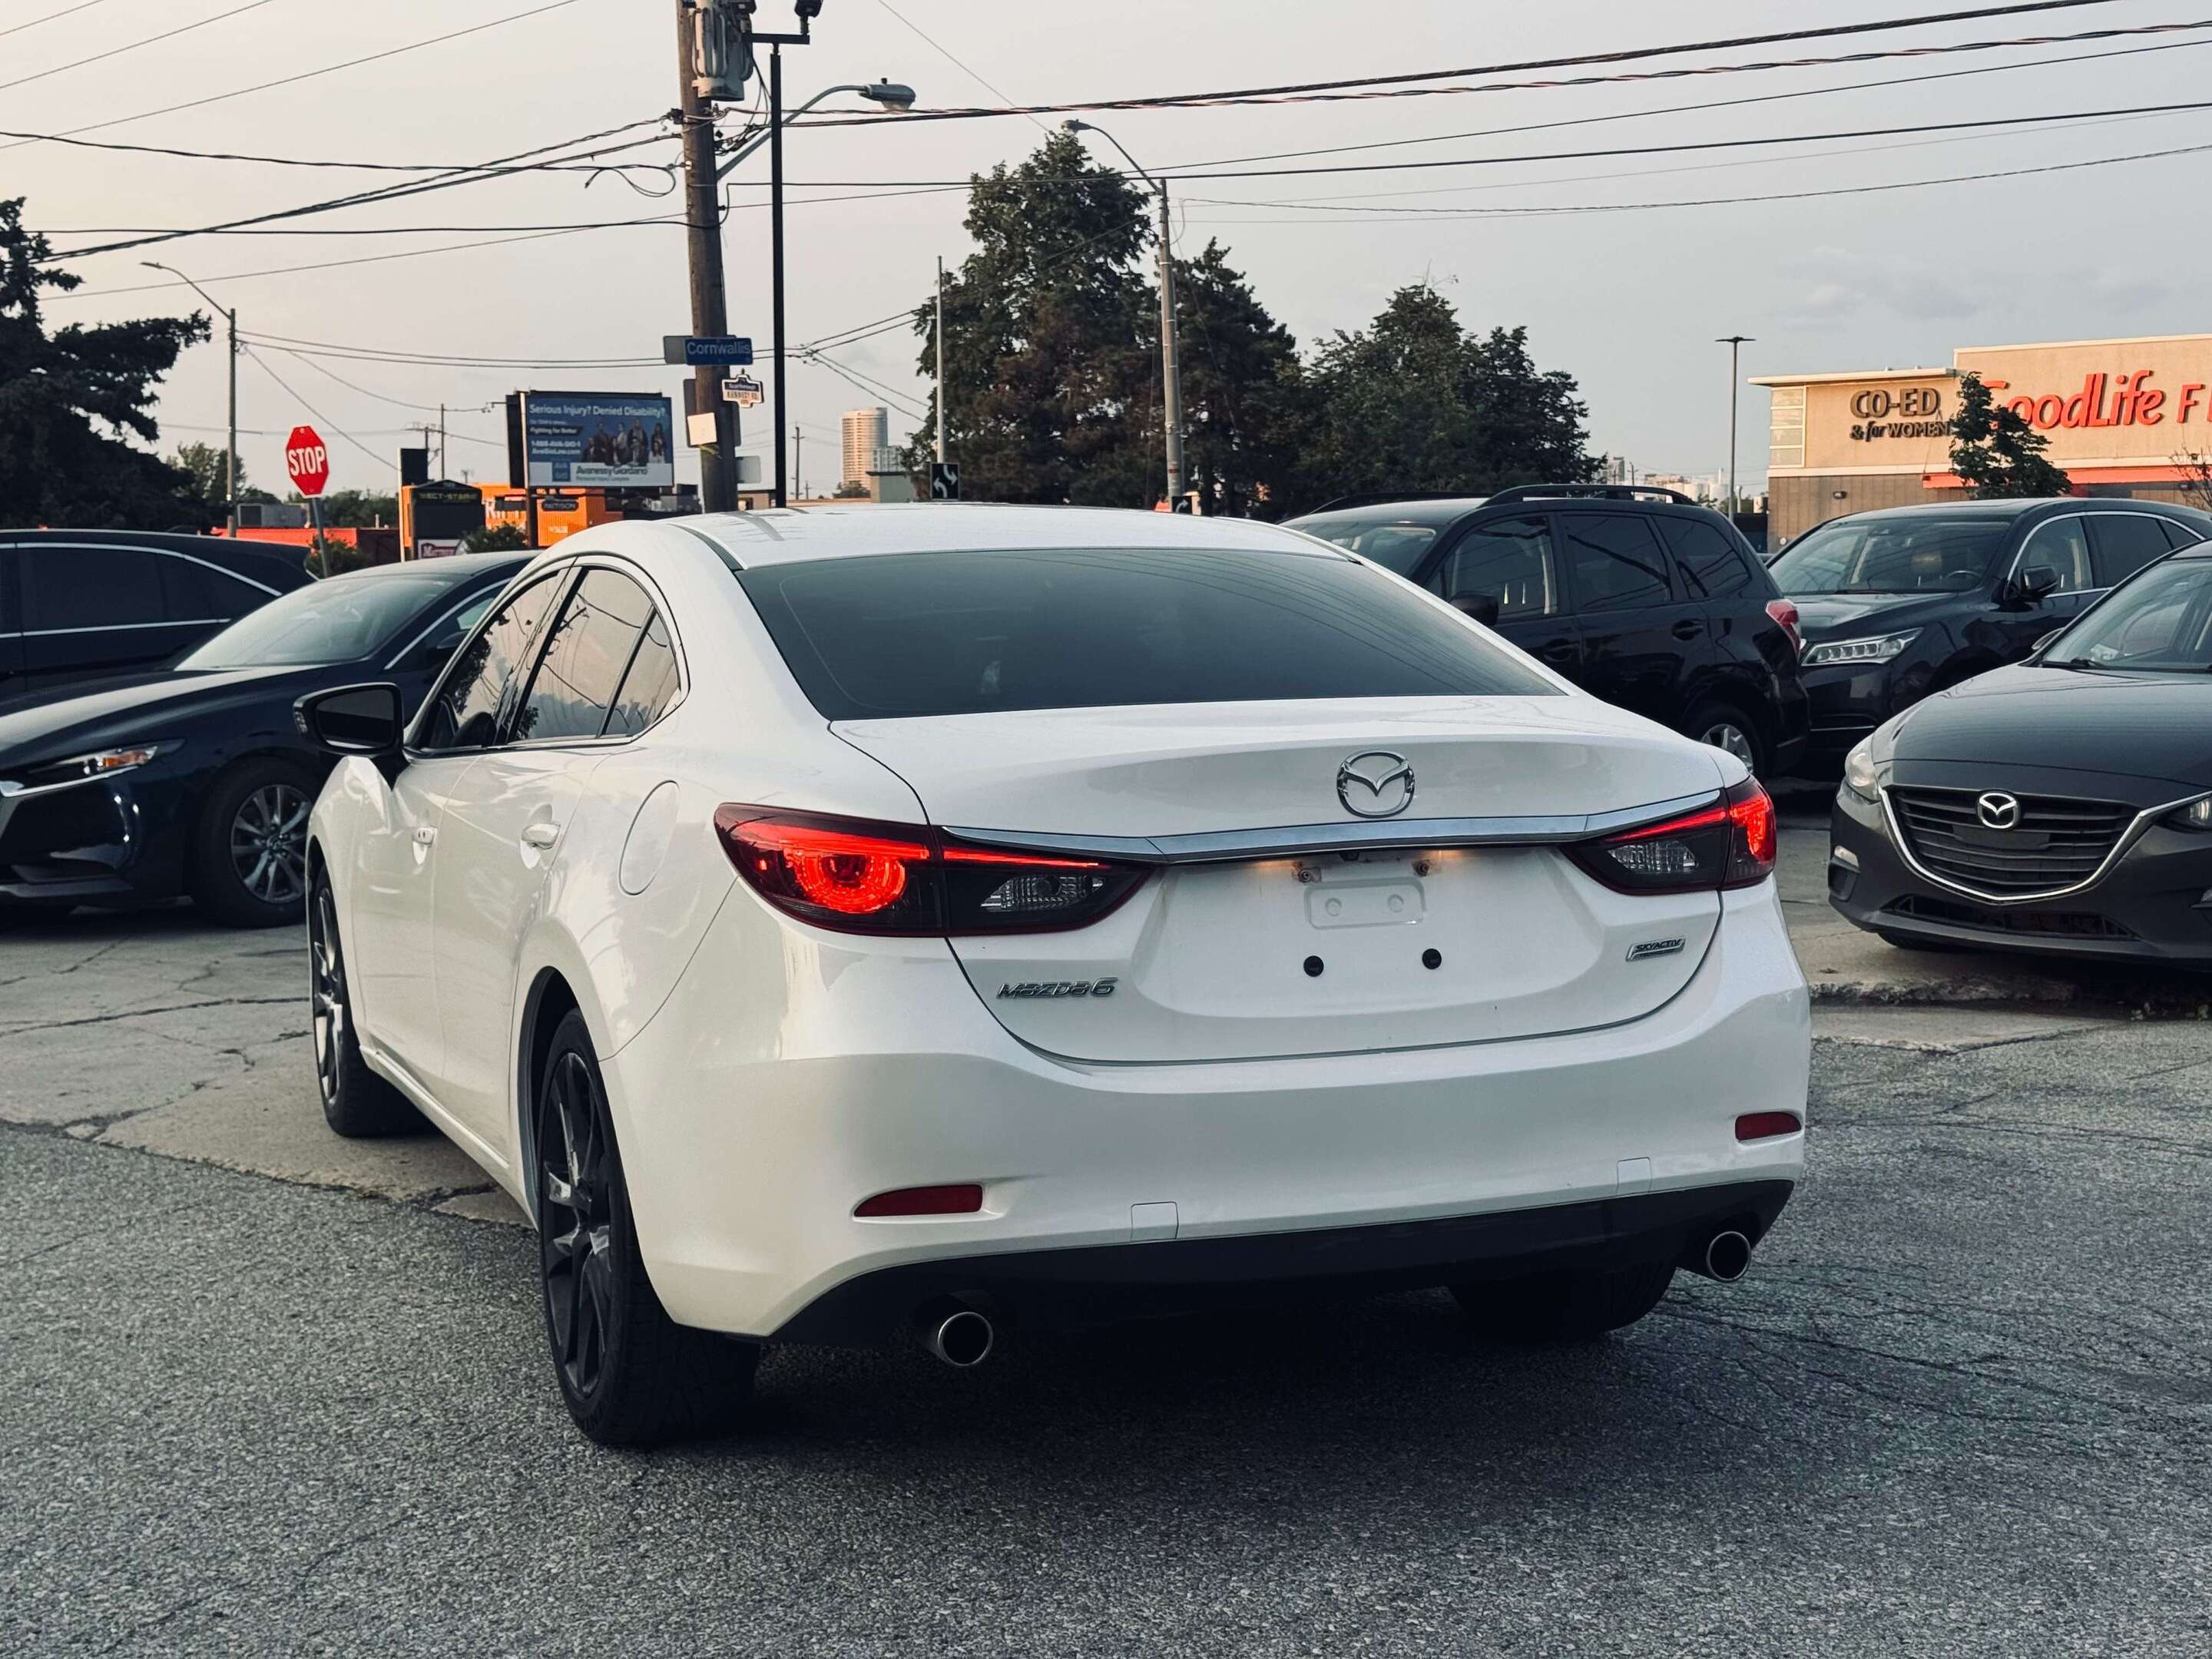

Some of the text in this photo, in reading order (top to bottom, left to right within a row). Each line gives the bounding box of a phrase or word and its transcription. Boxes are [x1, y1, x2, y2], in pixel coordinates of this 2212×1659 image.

[687, 341, 750, 355] Cornwallis
[529, 404, 666, 418] Serious Injury? Denied Disability?
[1849, 388, 1941, 419] CO-ED
[1849, 421, 1951, 442] & for WOMEN
[288, 446, 325, 476] STOP
[1634, 939, 1681, 952] SKYACTIV
